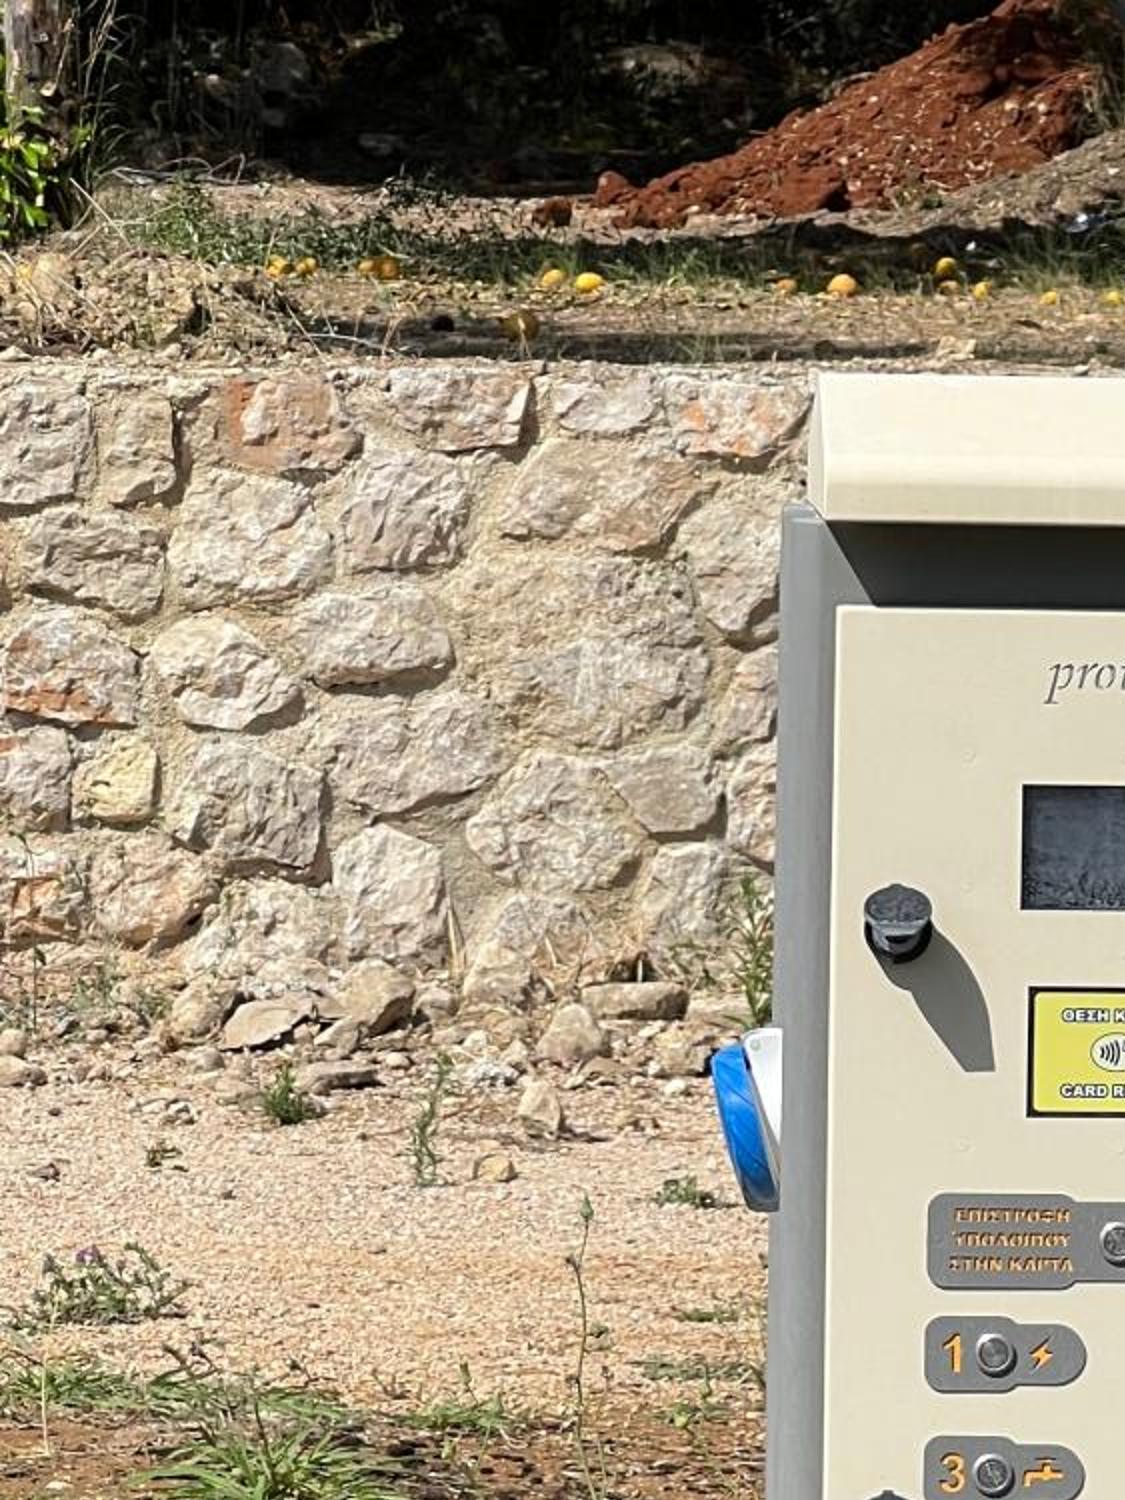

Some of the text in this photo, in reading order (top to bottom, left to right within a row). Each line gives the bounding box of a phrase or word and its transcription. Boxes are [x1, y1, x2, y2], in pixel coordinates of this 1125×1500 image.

[1062, 1007, 1111, 1023] ΘΕΣΗ
[1060, 1083, 1109, 1099] CARD
[942, 1332, 963, 1374] 1
[938, 1452, 967, 1494] 3
